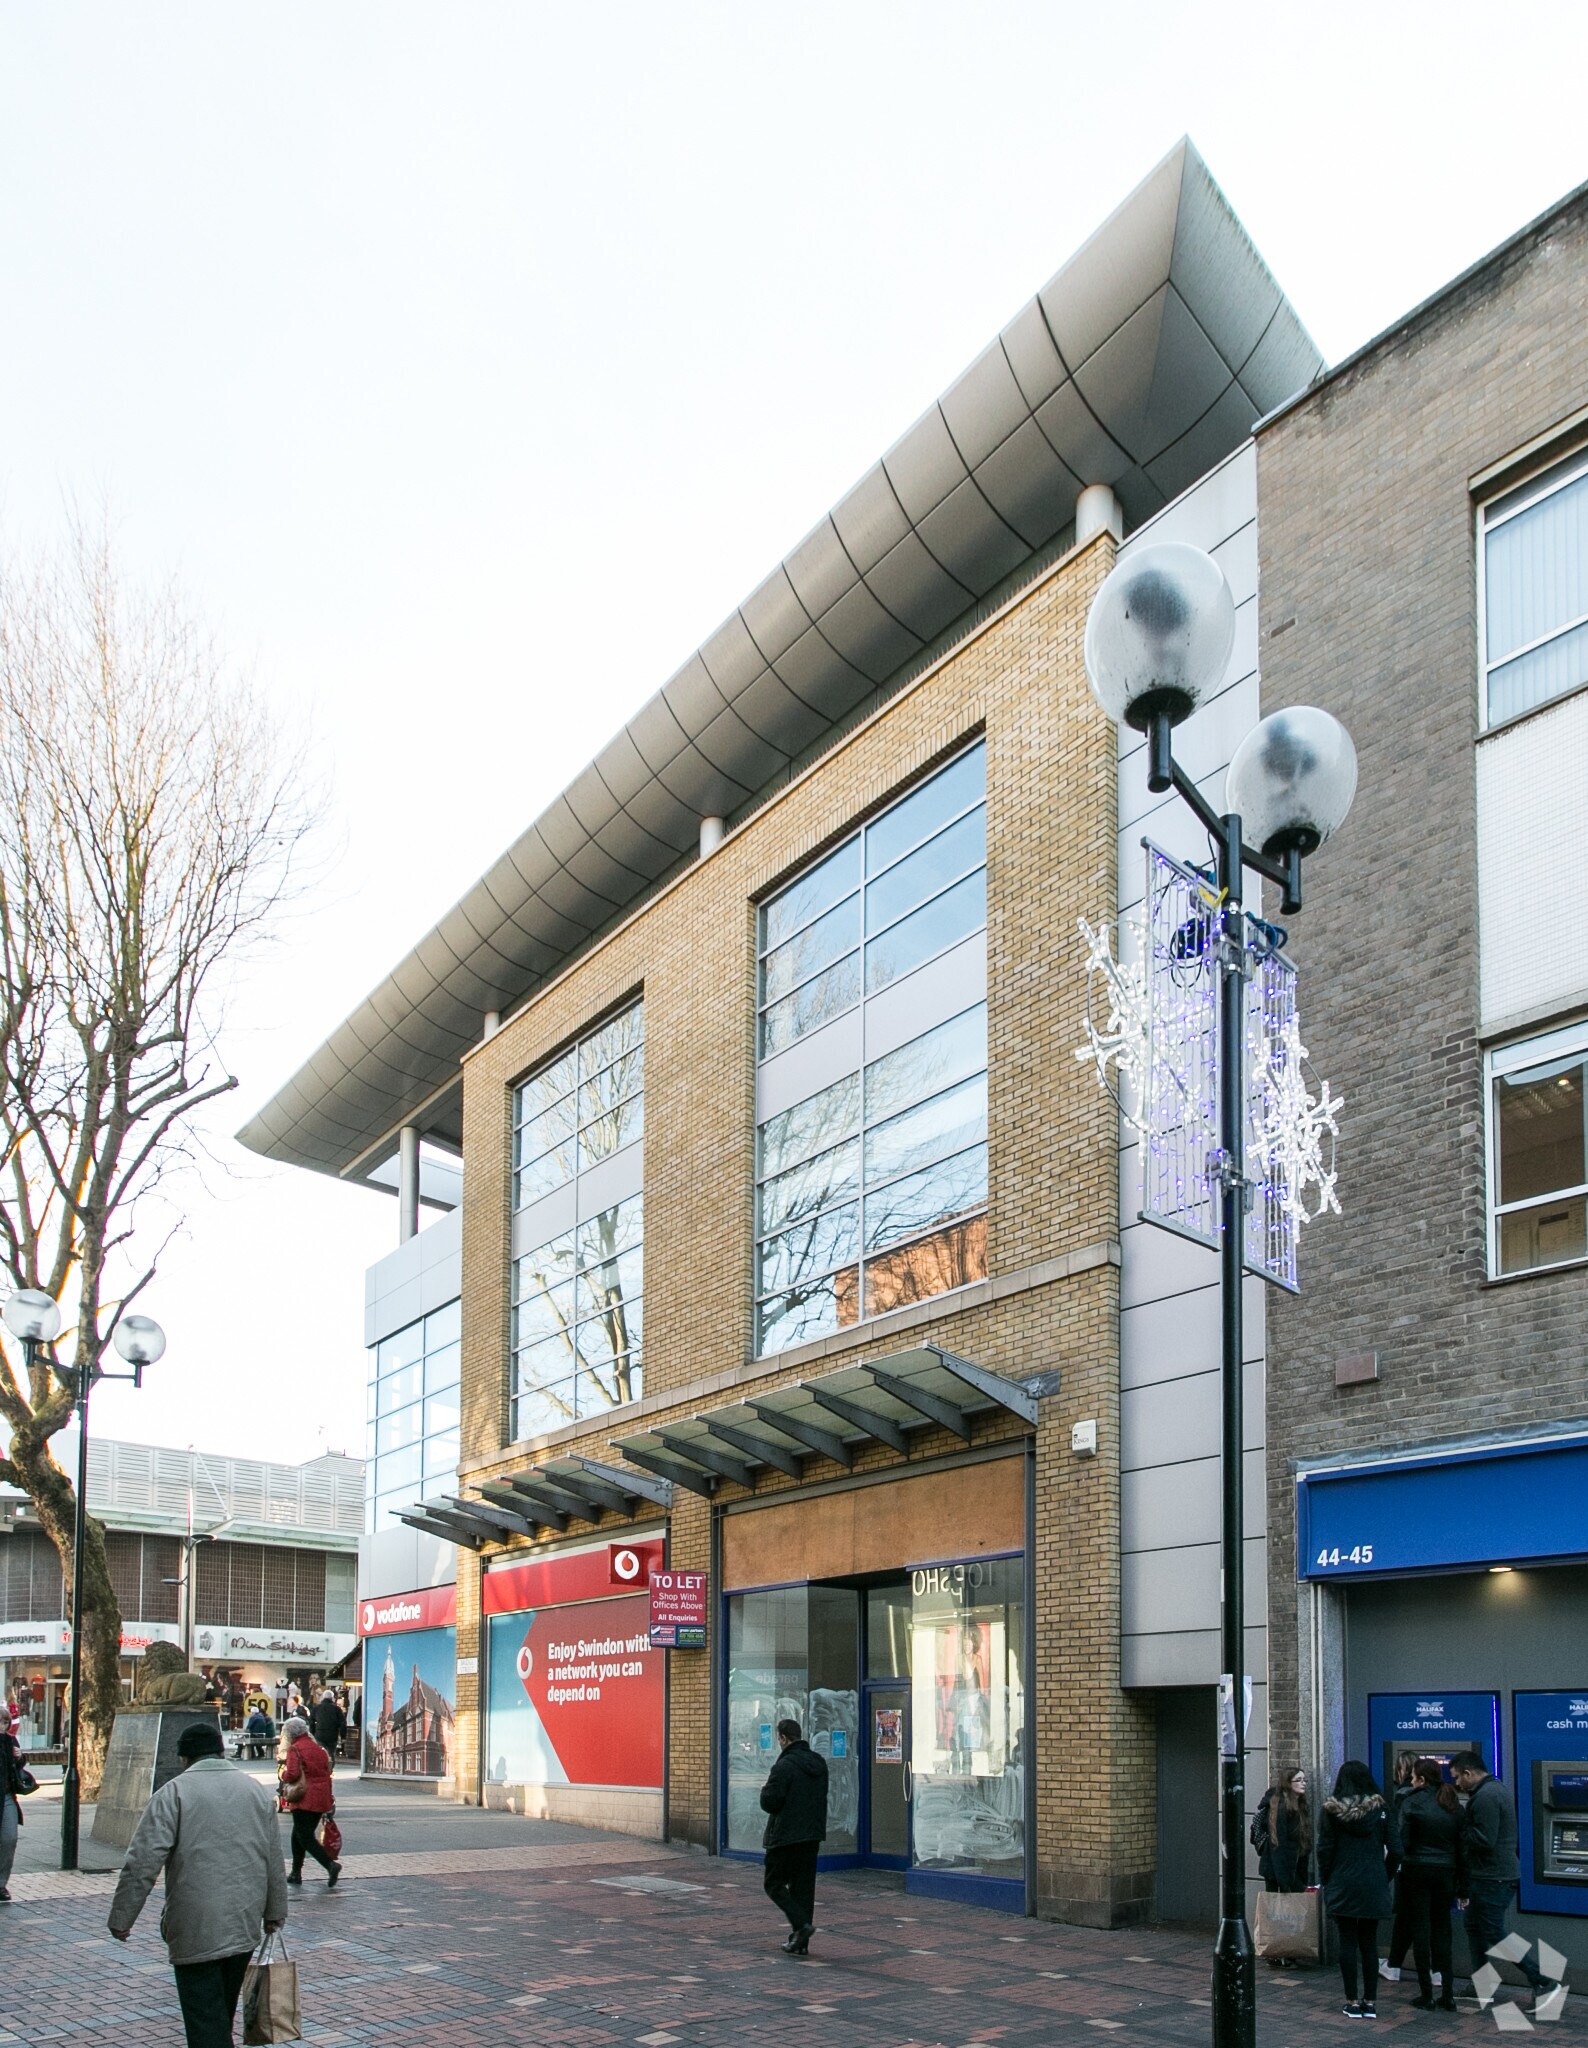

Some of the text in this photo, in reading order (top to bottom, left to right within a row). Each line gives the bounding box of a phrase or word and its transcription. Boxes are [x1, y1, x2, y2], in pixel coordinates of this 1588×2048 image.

[1316, 1545, 1373, 1567] 44-45
[653, 1575, 703, 1589] TO LET
[658, 1592, 697, 1601] Shop With
[376, 1600, 421, 1625] vodafone
[652, 1601, 703, 1610] Offices Above
[668, 1614, 698, 1622] Enquiries
[231, 1636, 325, 1656] Miss Selfridge
[548, 1633, 652, 1662] Enjoy Swindon with
[547, 1660, 643, 1682] a network you can
[547, 1684, 601, 1705] depend on
[1396, 1719, 1466, 1730] cash machine
[1546, 1718, 1573, 1729] cash
